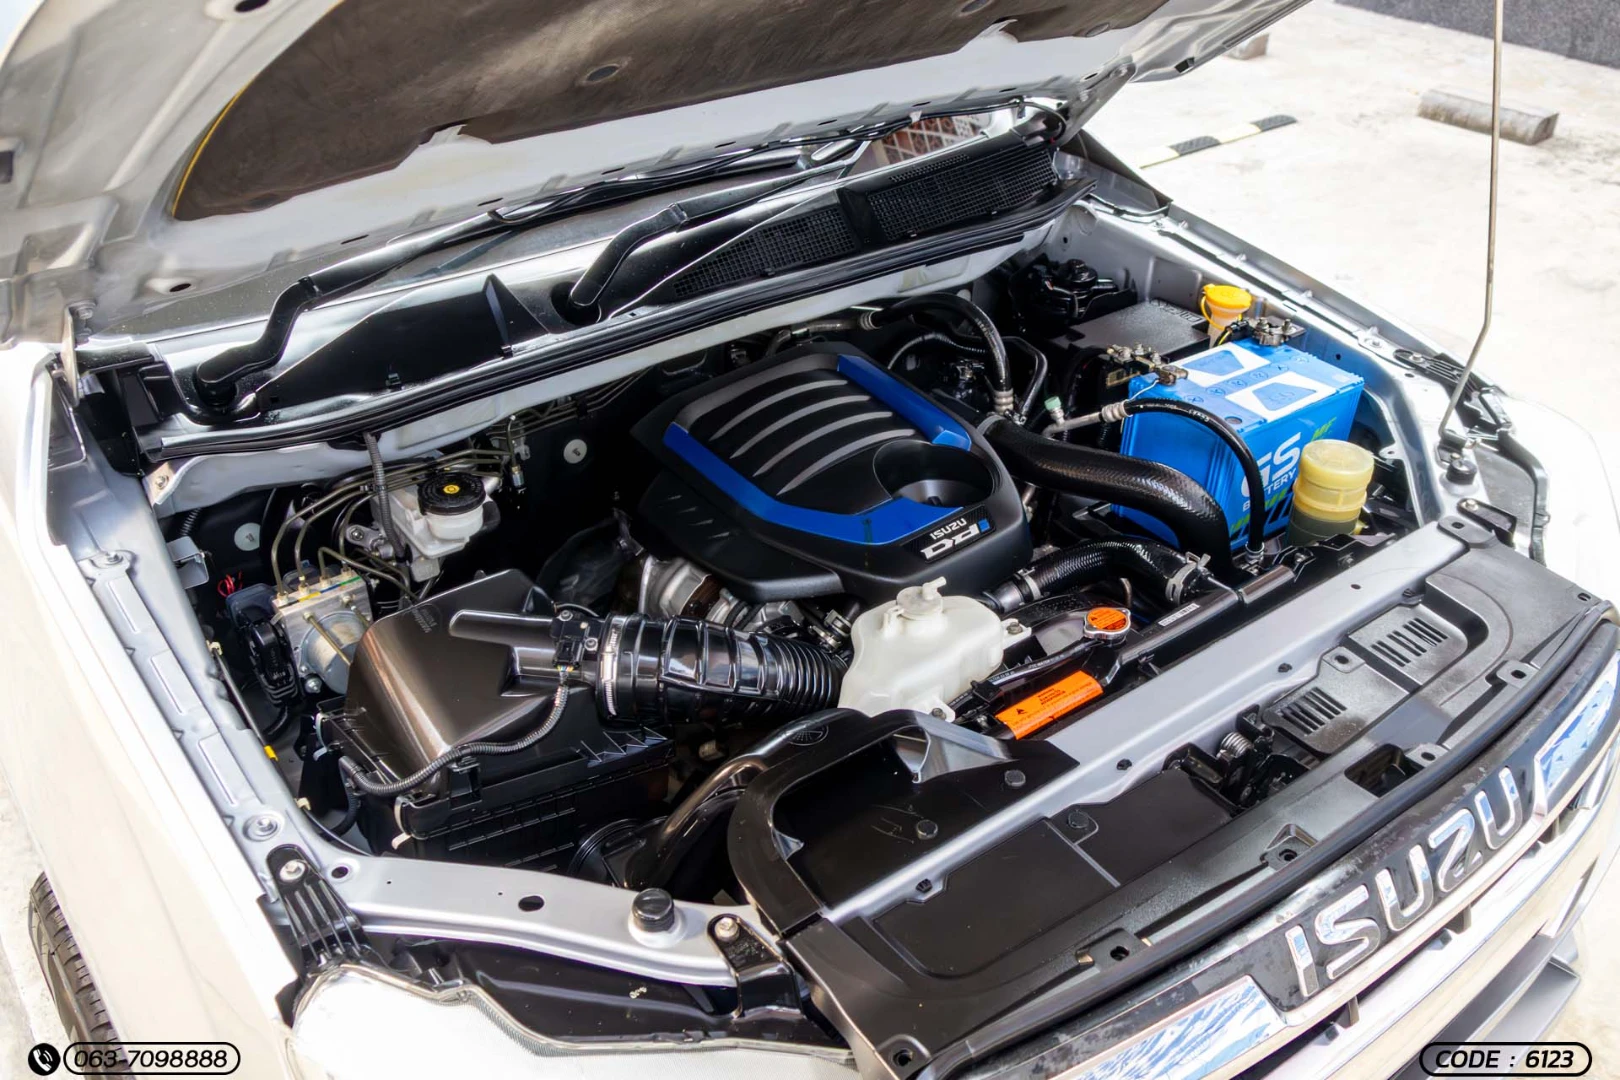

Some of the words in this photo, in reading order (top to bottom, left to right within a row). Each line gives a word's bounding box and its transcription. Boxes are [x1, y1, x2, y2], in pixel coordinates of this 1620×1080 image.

[1242, 467, 1297, 513] BTERY
[929, 517, 967, 540] ISUZU
[1284, 765, 1524, 998] ISUZU
